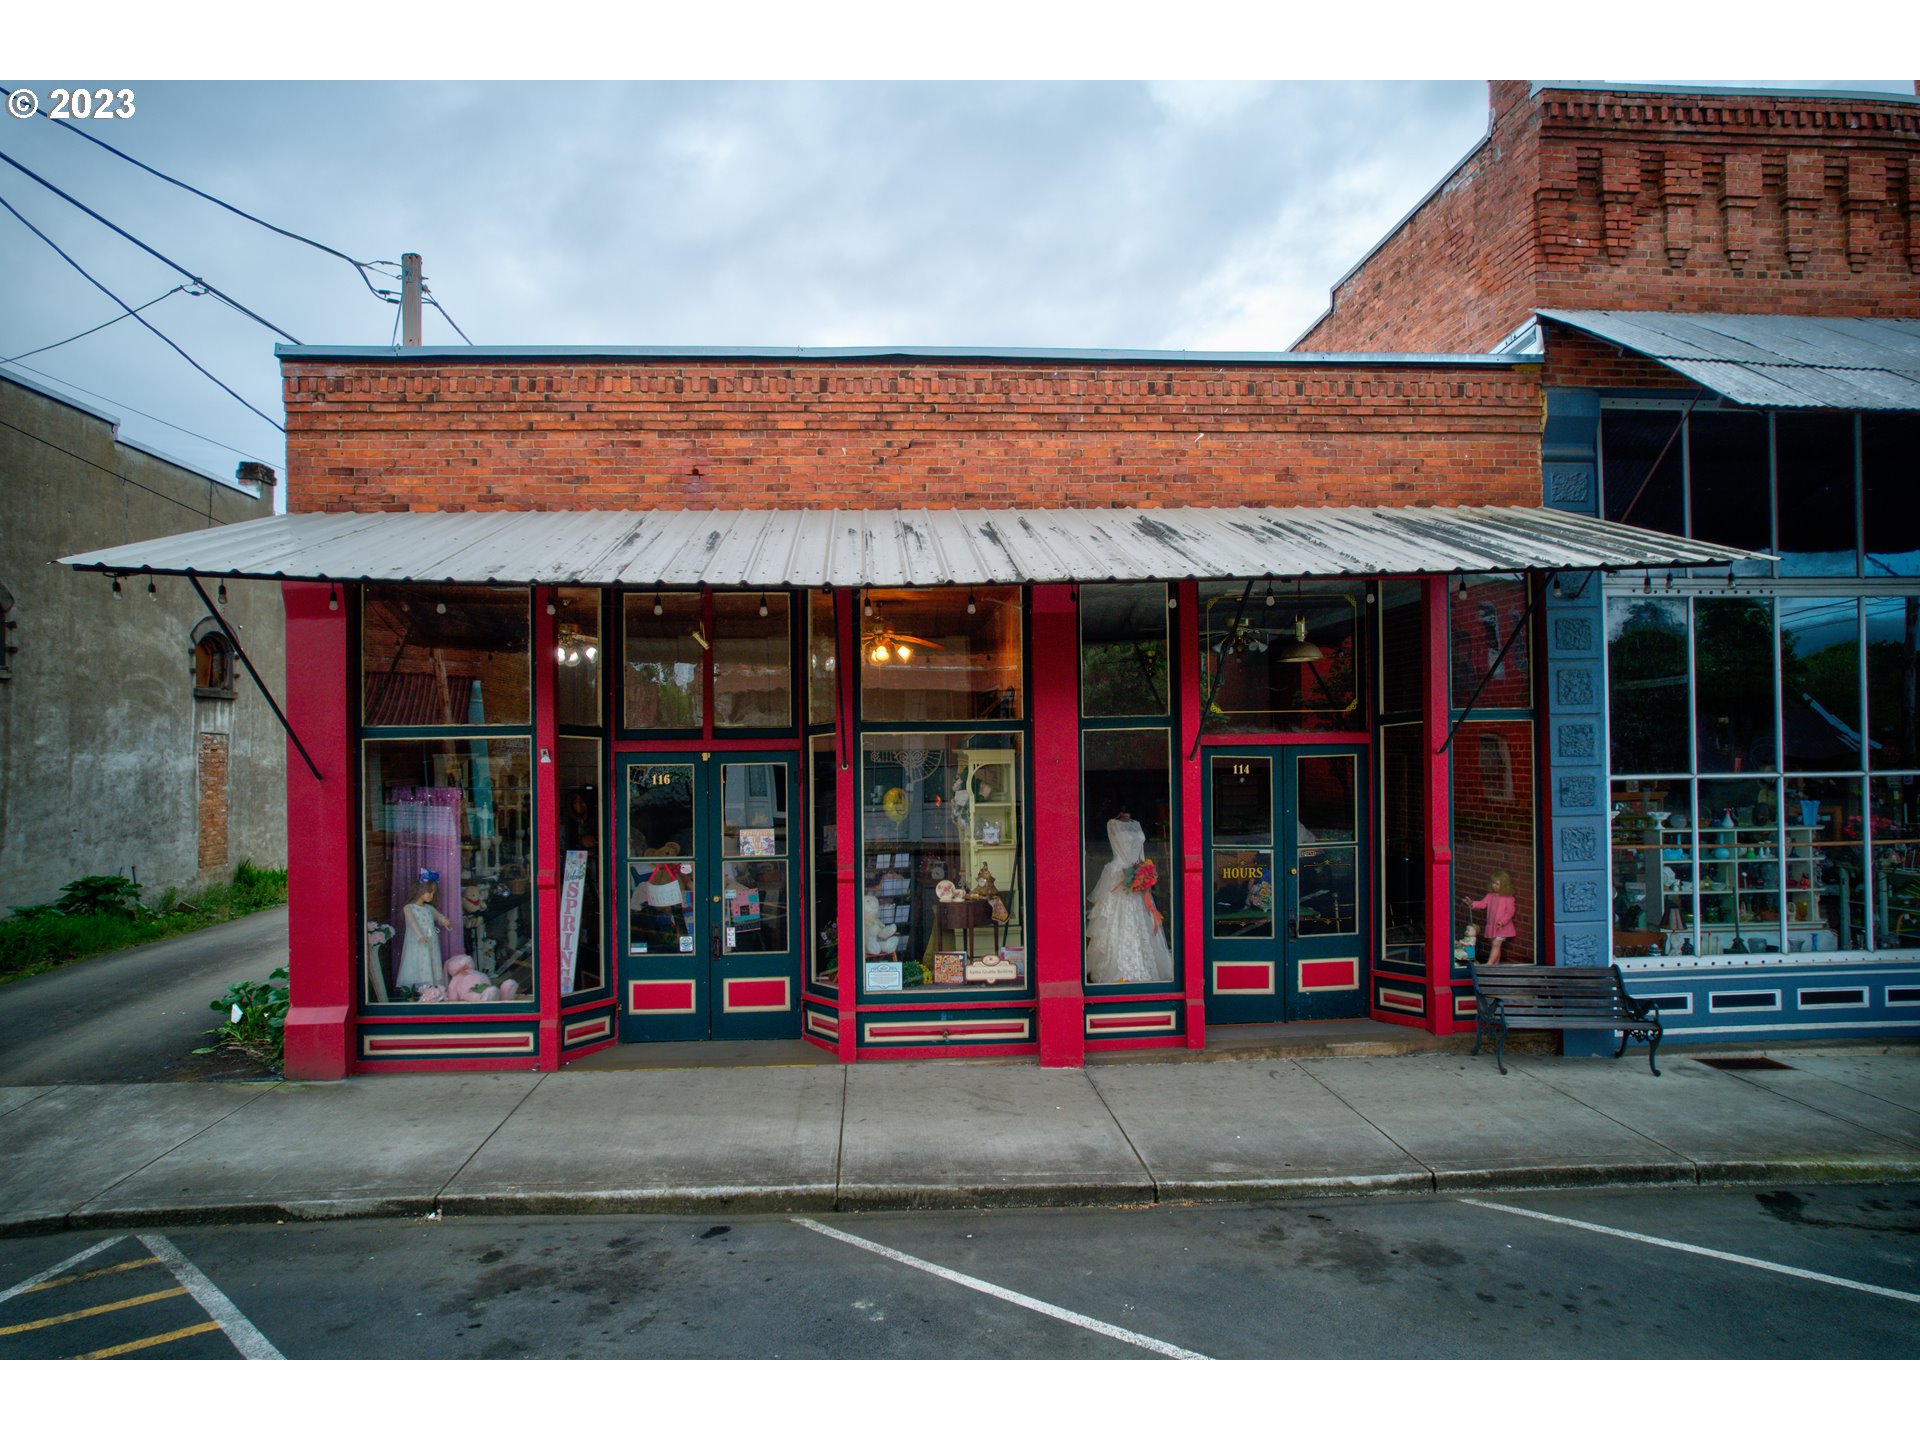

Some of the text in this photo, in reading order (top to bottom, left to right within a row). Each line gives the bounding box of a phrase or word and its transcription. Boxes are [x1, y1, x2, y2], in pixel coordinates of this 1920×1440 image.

[1233, 764, 1250, 775] 114
[652, 773, 671, 785] 116
[1222, 867, 1263, 879] HOURS
